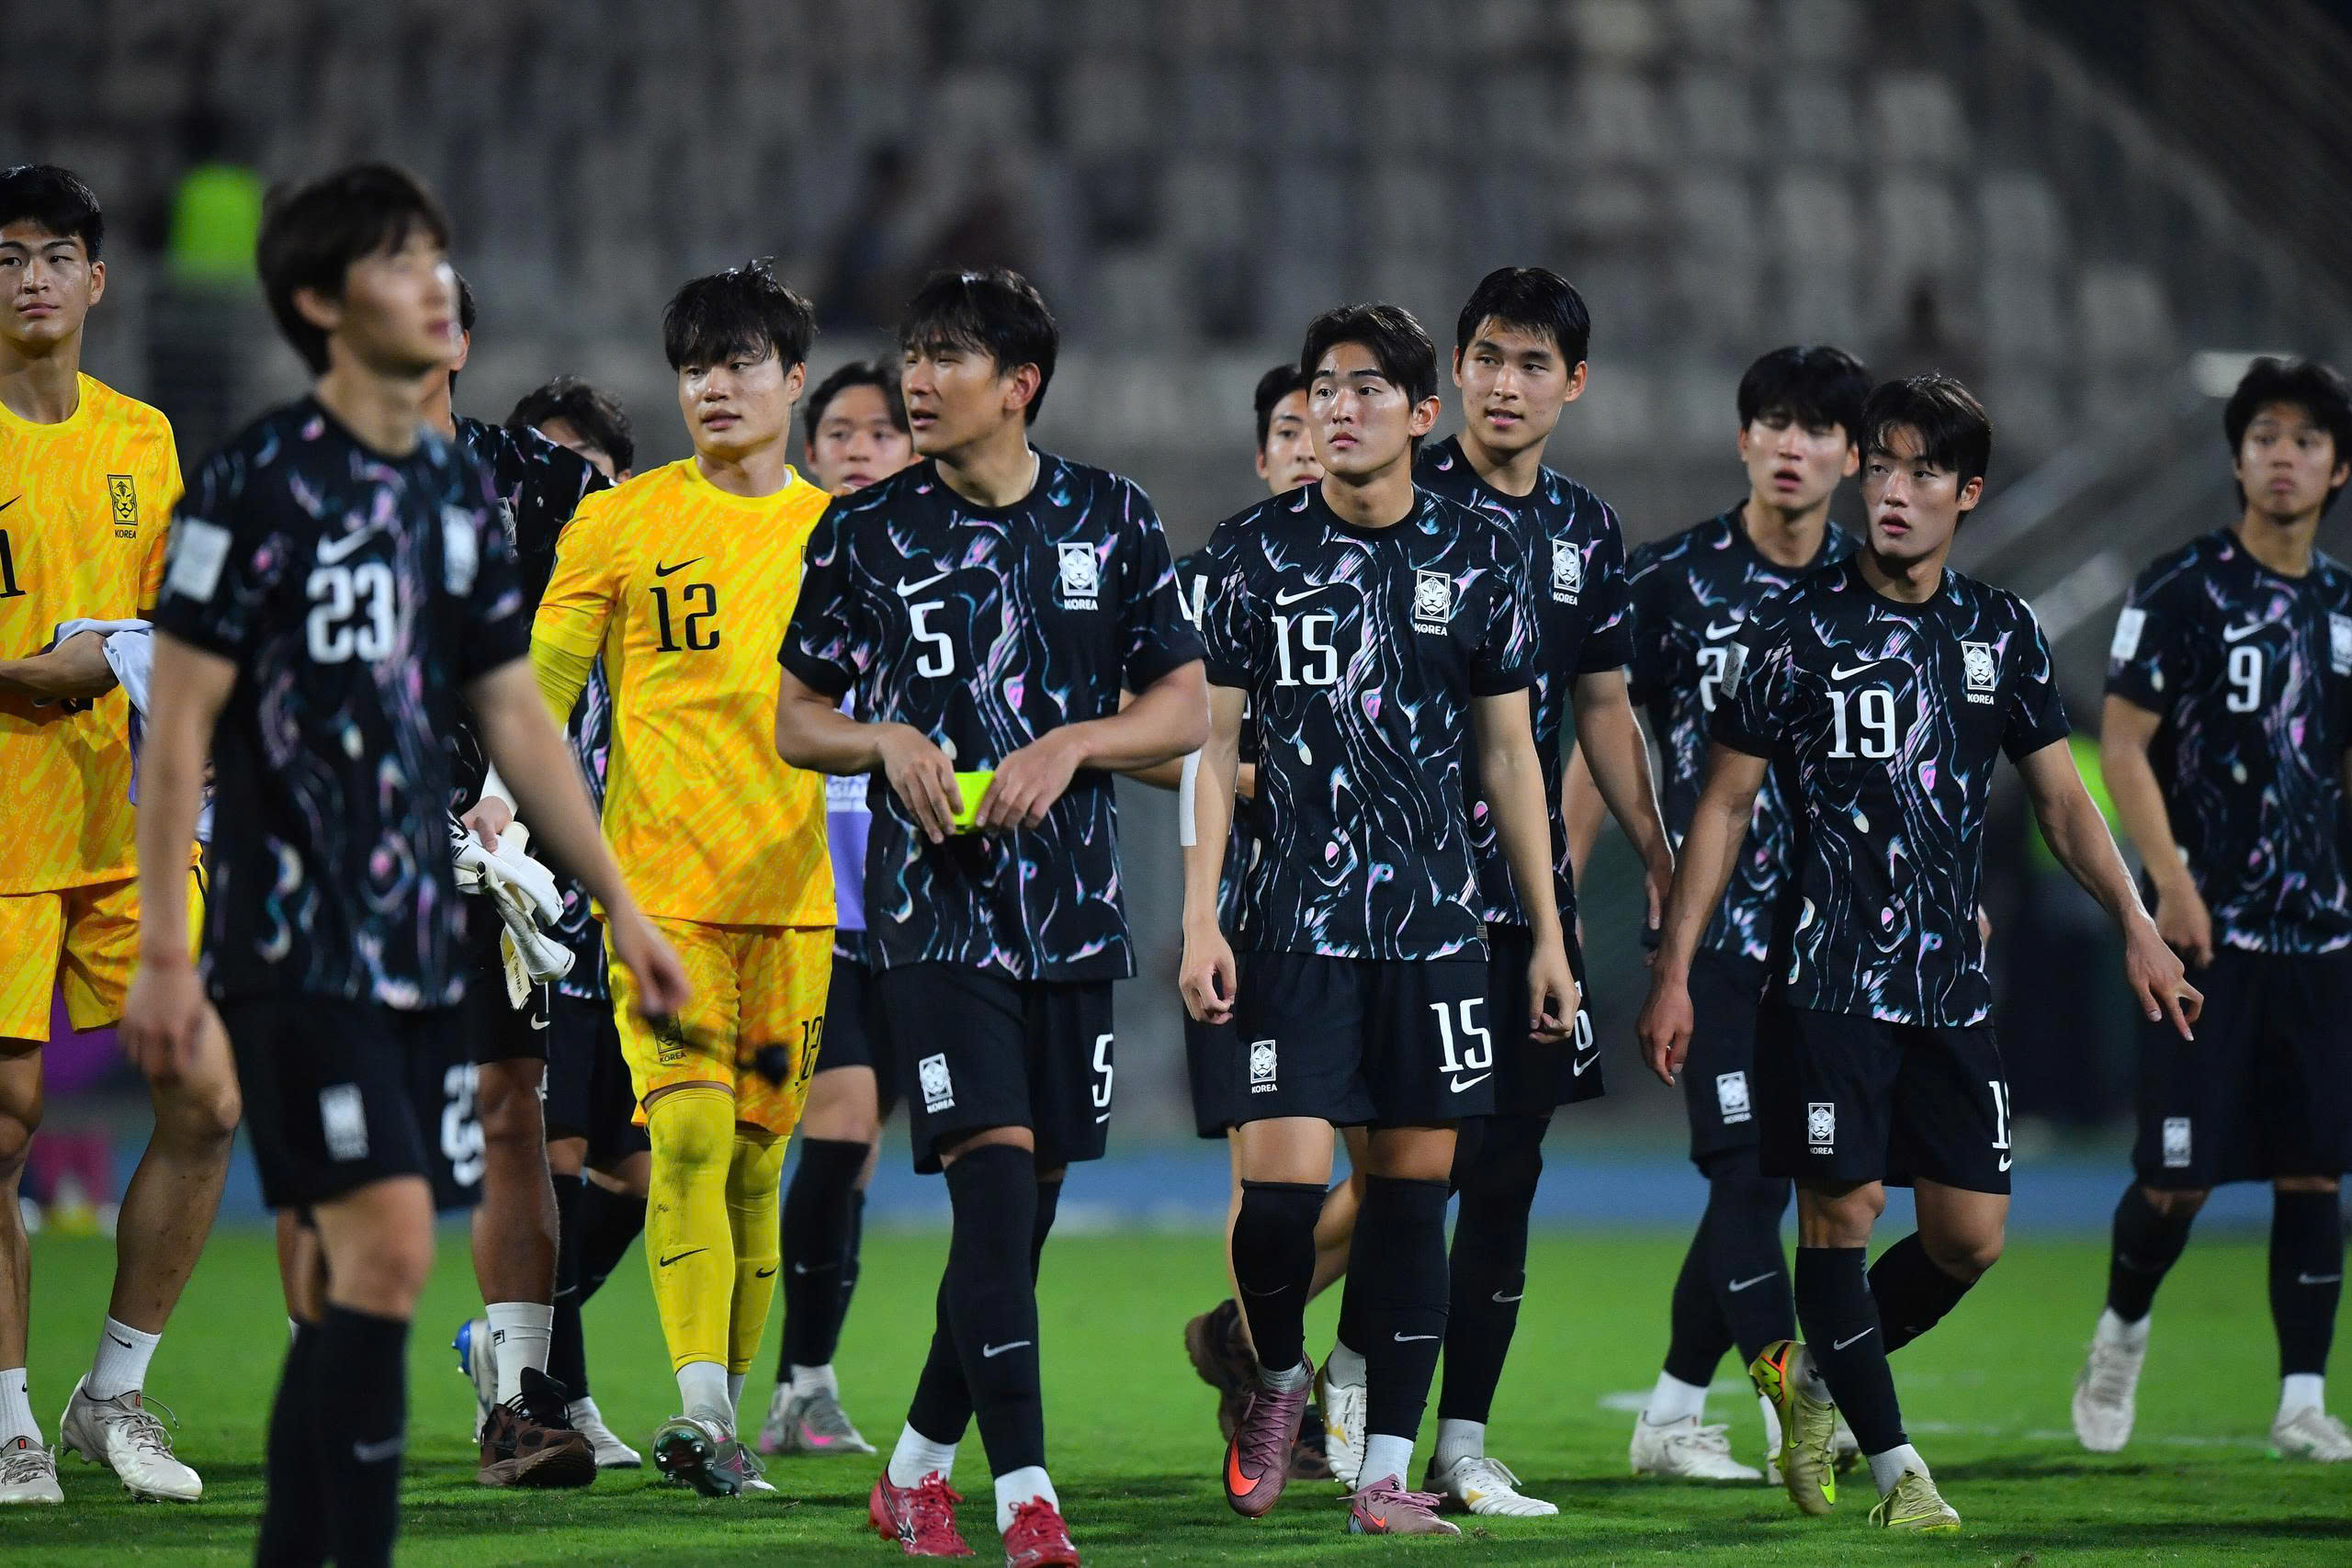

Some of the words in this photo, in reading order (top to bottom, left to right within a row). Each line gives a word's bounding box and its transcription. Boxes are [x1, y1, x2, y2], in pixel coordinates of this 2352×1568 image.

[114, 529, 137, 539] KOREA
[306, 562, 396, 663] 23
[649, 582, 720, 652] 12
[1064, 599, 1099, 611] KOREA
[1414, 622, 1448, 637] KOREA
[1553, 591, 1578, 606] KOREA
[910, 601, 956, 678] 5
[1271, 615, 1338, 686] 15
[1967, 693, 1995, 705] KOREA
[2226, 646, 2262, 713] 9
[1825, 689, 1896, 759] 19
[659, 1053, 687, 1063] KOREA
[795, 1015, 824, 1087] 12
[1429, 997, 1493, 1073] 15
[1091, 1032, 1114, 1108] 5
[1251, 1083, 1278, 1094] KOREA
[1988, 1080, 2012, 1149] 1
[1809, 1146, 1835, 1155] KOREA
